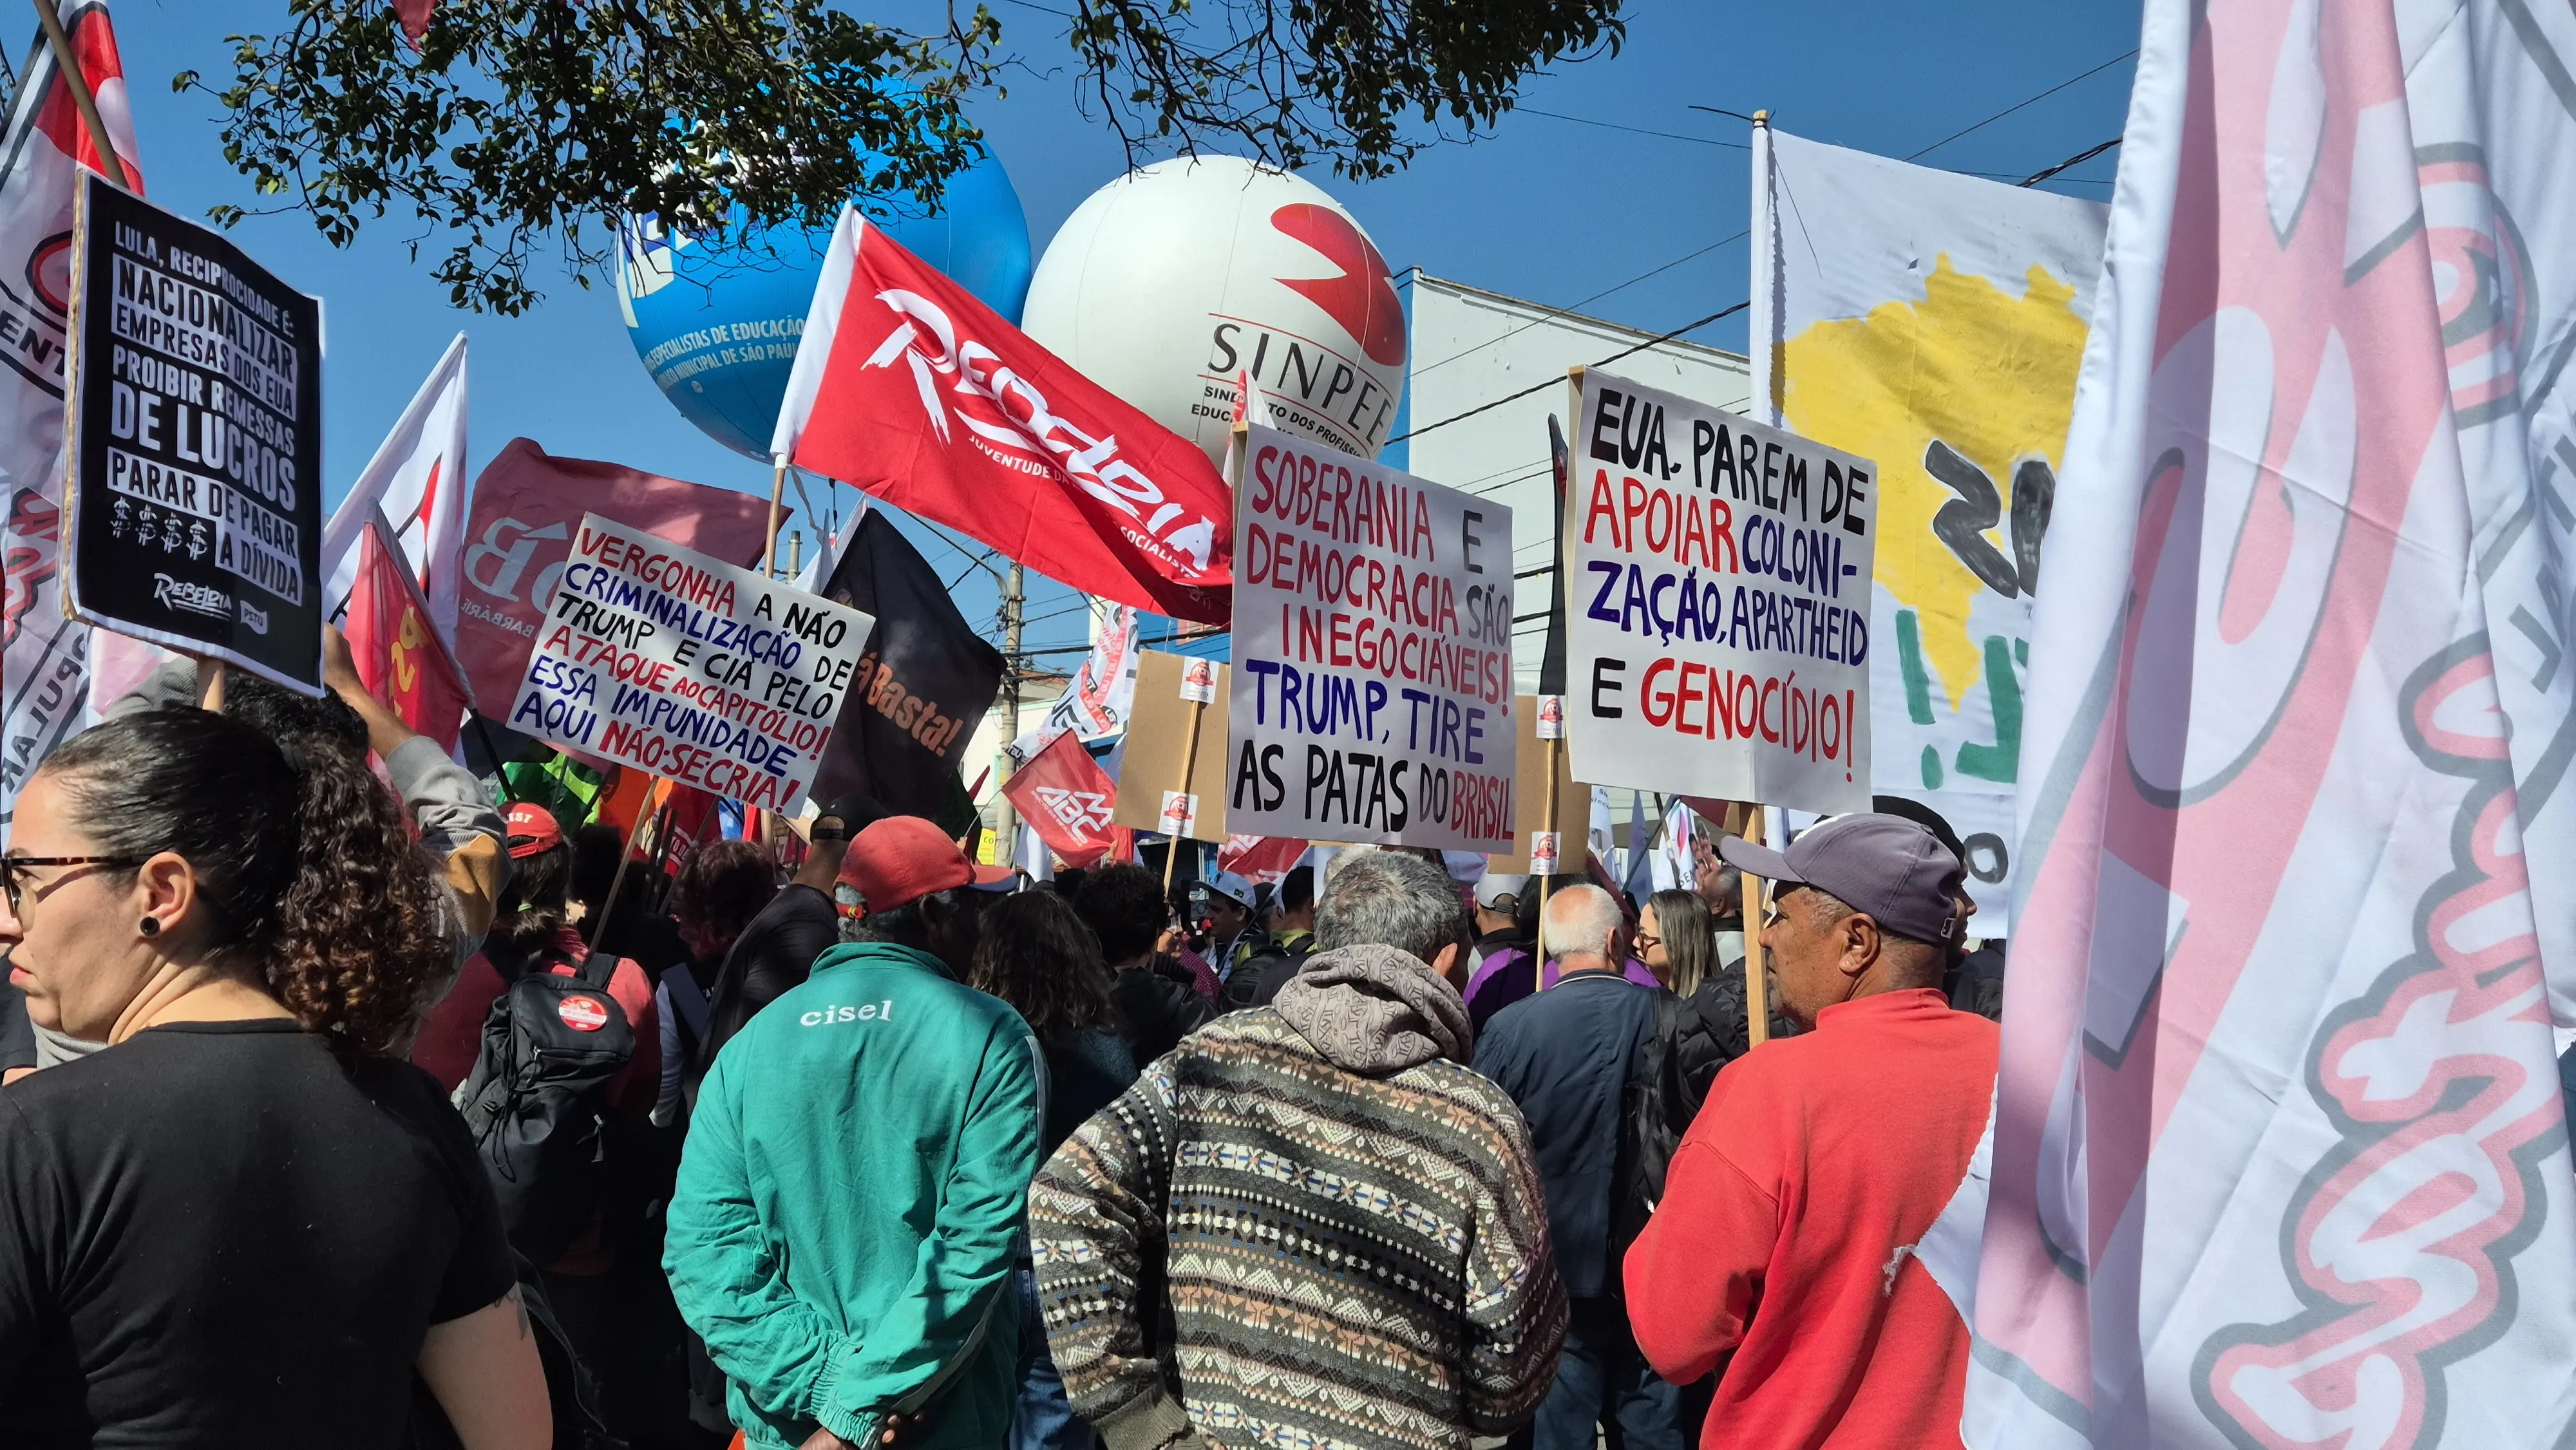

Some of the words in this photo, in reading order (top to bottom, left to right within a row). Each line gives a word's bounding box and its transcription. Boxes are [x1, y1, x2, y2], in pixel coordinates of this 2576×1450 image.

[115, 221, 164, 268] LULA,
[170, 245, 279, 328] RECIPROCIDADE
[118, 259, 292, 382] NACIONALIZAR
[117, 303, 229, 373] EMPRESAS
[234, 352, 261, 395] DOS
[265, 377, 292, 417] EUA
[650, 329, 710, 366] ESPECIALISTAS
[710, 325, 730, 344] DE
[730, 315, 805, 341] EDUCAÇÃO
[674, 353, 723, 380] MUNICIPAL
[721, 348, 739, 365] DE
[739, 343, 764, 362] SÃO
[111, 379, 160, 451] DE
[176, 403, 296, 511] LUCROS
[113, 344, 204, 406] PROIBIR
[211, 379, 295, 457] REMESSAS
[968, 435, 1051, 479] JUVENTUDE
[1289, 412, 1314, 431] DOS
[112, 451, 198, 512] PARAR
[209, 482, 235, 524] DE
[240, 497, 296, 558] PAGAR
[1252, 446, 1435, 562] SOBERANIA
[1463, 510, 1483, 574] E
[1590, 388, 1681, 481] EUA,
[1693, 419, 1807, 522] PAREM
[1821, 458, 1869, 536] DE
[220, 532, 233, 567] A
[240, 543, 299, 601] DÍVIDA
[581, 527, 735, 617] VERGONHA
[753, 593, 772, 621] A
[782, 602, 847, 648] NÃO
[1247, 522, 1459, 637] DEMOCRACIA
[1467, 583, 1509, 648] SÃO
[1584, 468, 1739, 574] APOIAR
[1742, 514, 1857, 599] COLONI-
[544, 625, 676, 694] ATAQUE
[556, 592, 655, 650] TRUMP
[672, 639, 700, 667] E
[764, 671, 833, 719] PELO
[565, 563, 801, 670] CRIMINALIZAÇÃO
[813, 655, 853, 691] DE
[1282, 604, 1509, 717] INEGOCIÁVEIS!
[1587, 560, 1727, 647] ZAÇÃO,
[1730, 585, 1868, 667] APARTHEID
[514, 692, 598, 745] AQUI
[528, 654, 596, 706] ESSA
[611, 684, 798, 777] IMPUNIDADE
[1245, 659, 1388, 745] TRUMP,
[1402, 688, 1486, 764] TIRE
[1592, 657, 1626, 719] E
[1640, 657, 1855, 784] GENOCÍDIO!
[1233, 739, 1285, 813] AS
[1305, 744, 1408, 833] PATAS
[1419, 766, 1448, 824] DO
[1451, 770, 1515, 841] BRASIL
[800, 1000, 893, 1026] cisel
